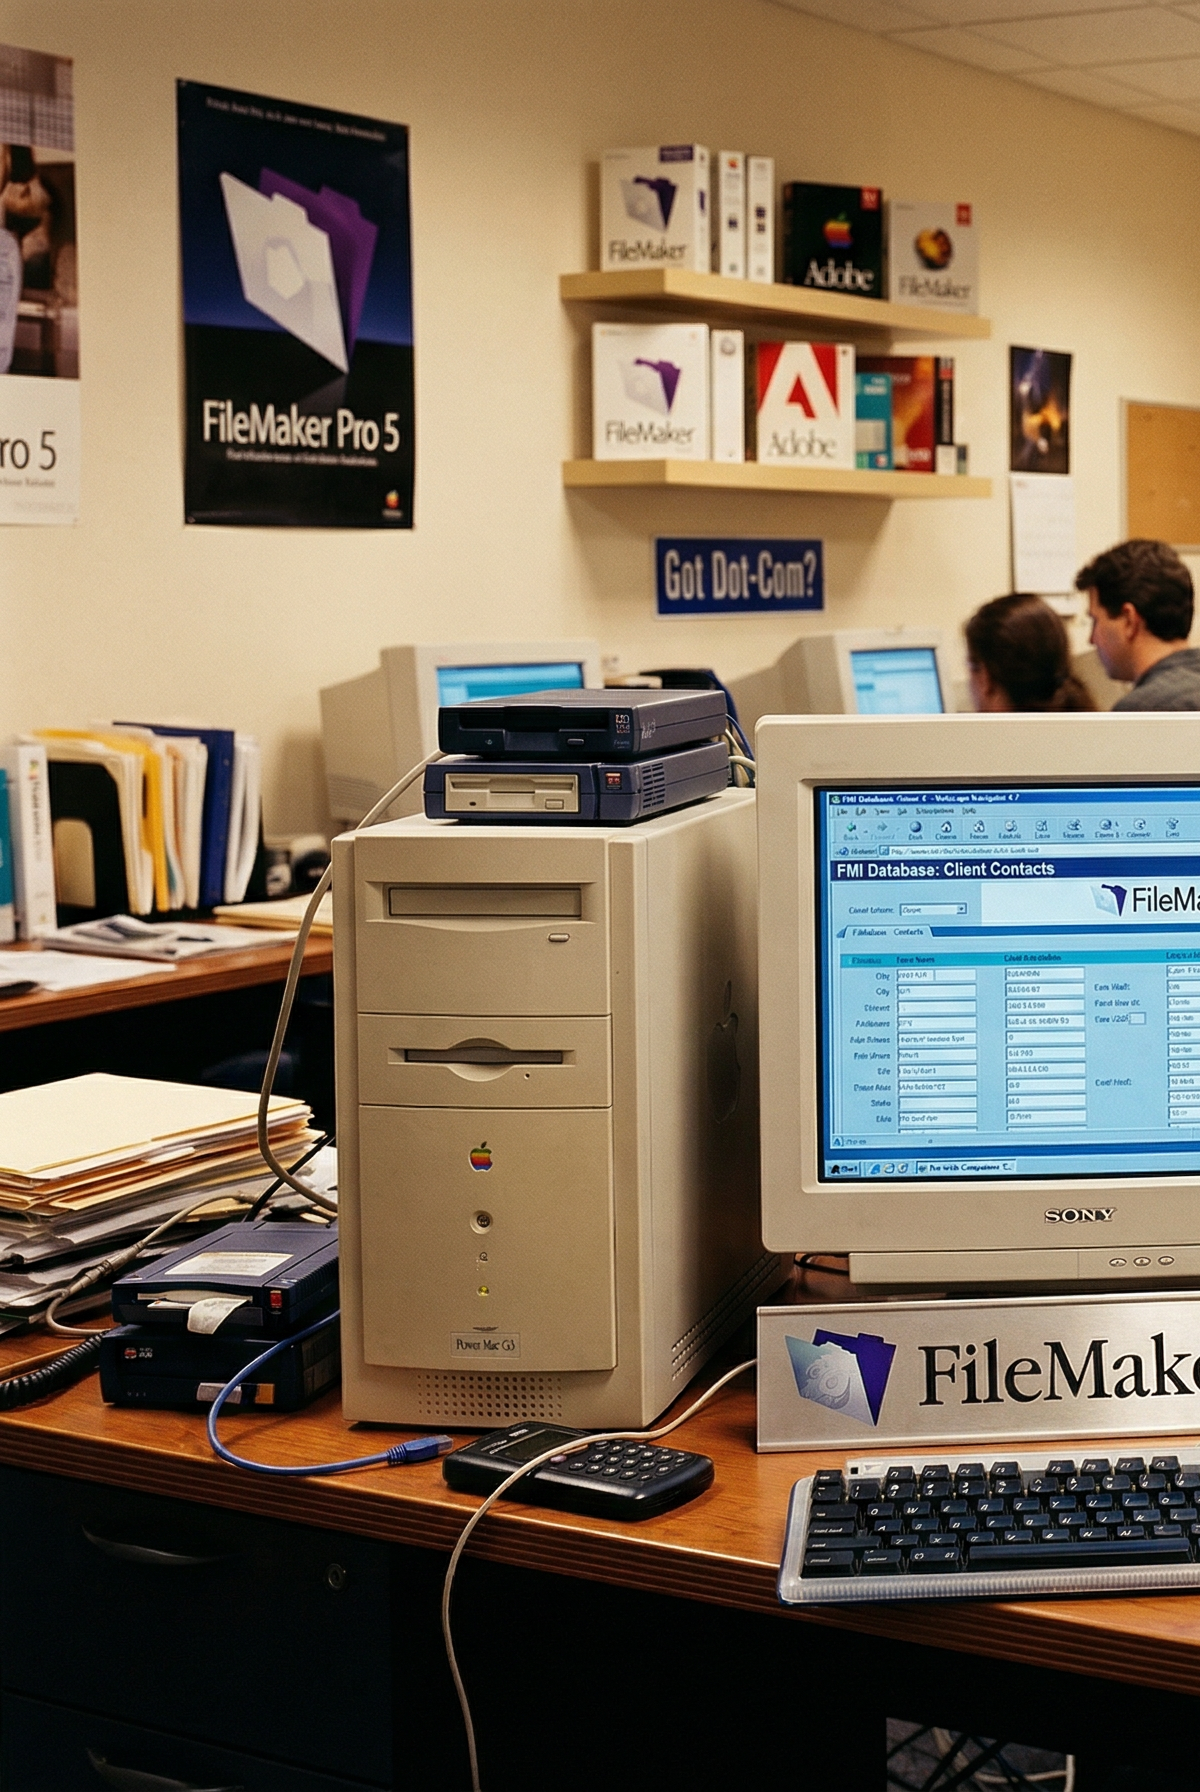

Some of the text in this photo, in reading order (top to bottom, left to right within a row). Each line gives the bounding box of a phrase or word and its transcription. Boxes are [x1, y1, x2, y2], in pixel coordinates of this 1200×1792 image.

[804, 257, 874, 291] Adobe
[203, 399, 400, 452] FileMaker Pro 5
[605, 420, 697, 445] FileMaker
[39, 430, 56, 470] 5
[767, 427, 837, 459] Adobe
[664, 549, 817, 600] Got Dot-Com?
[837, 861, 1055, 878] FMI Database: Client Contacts
[1044, 1208, 1116, 1223] SONY
